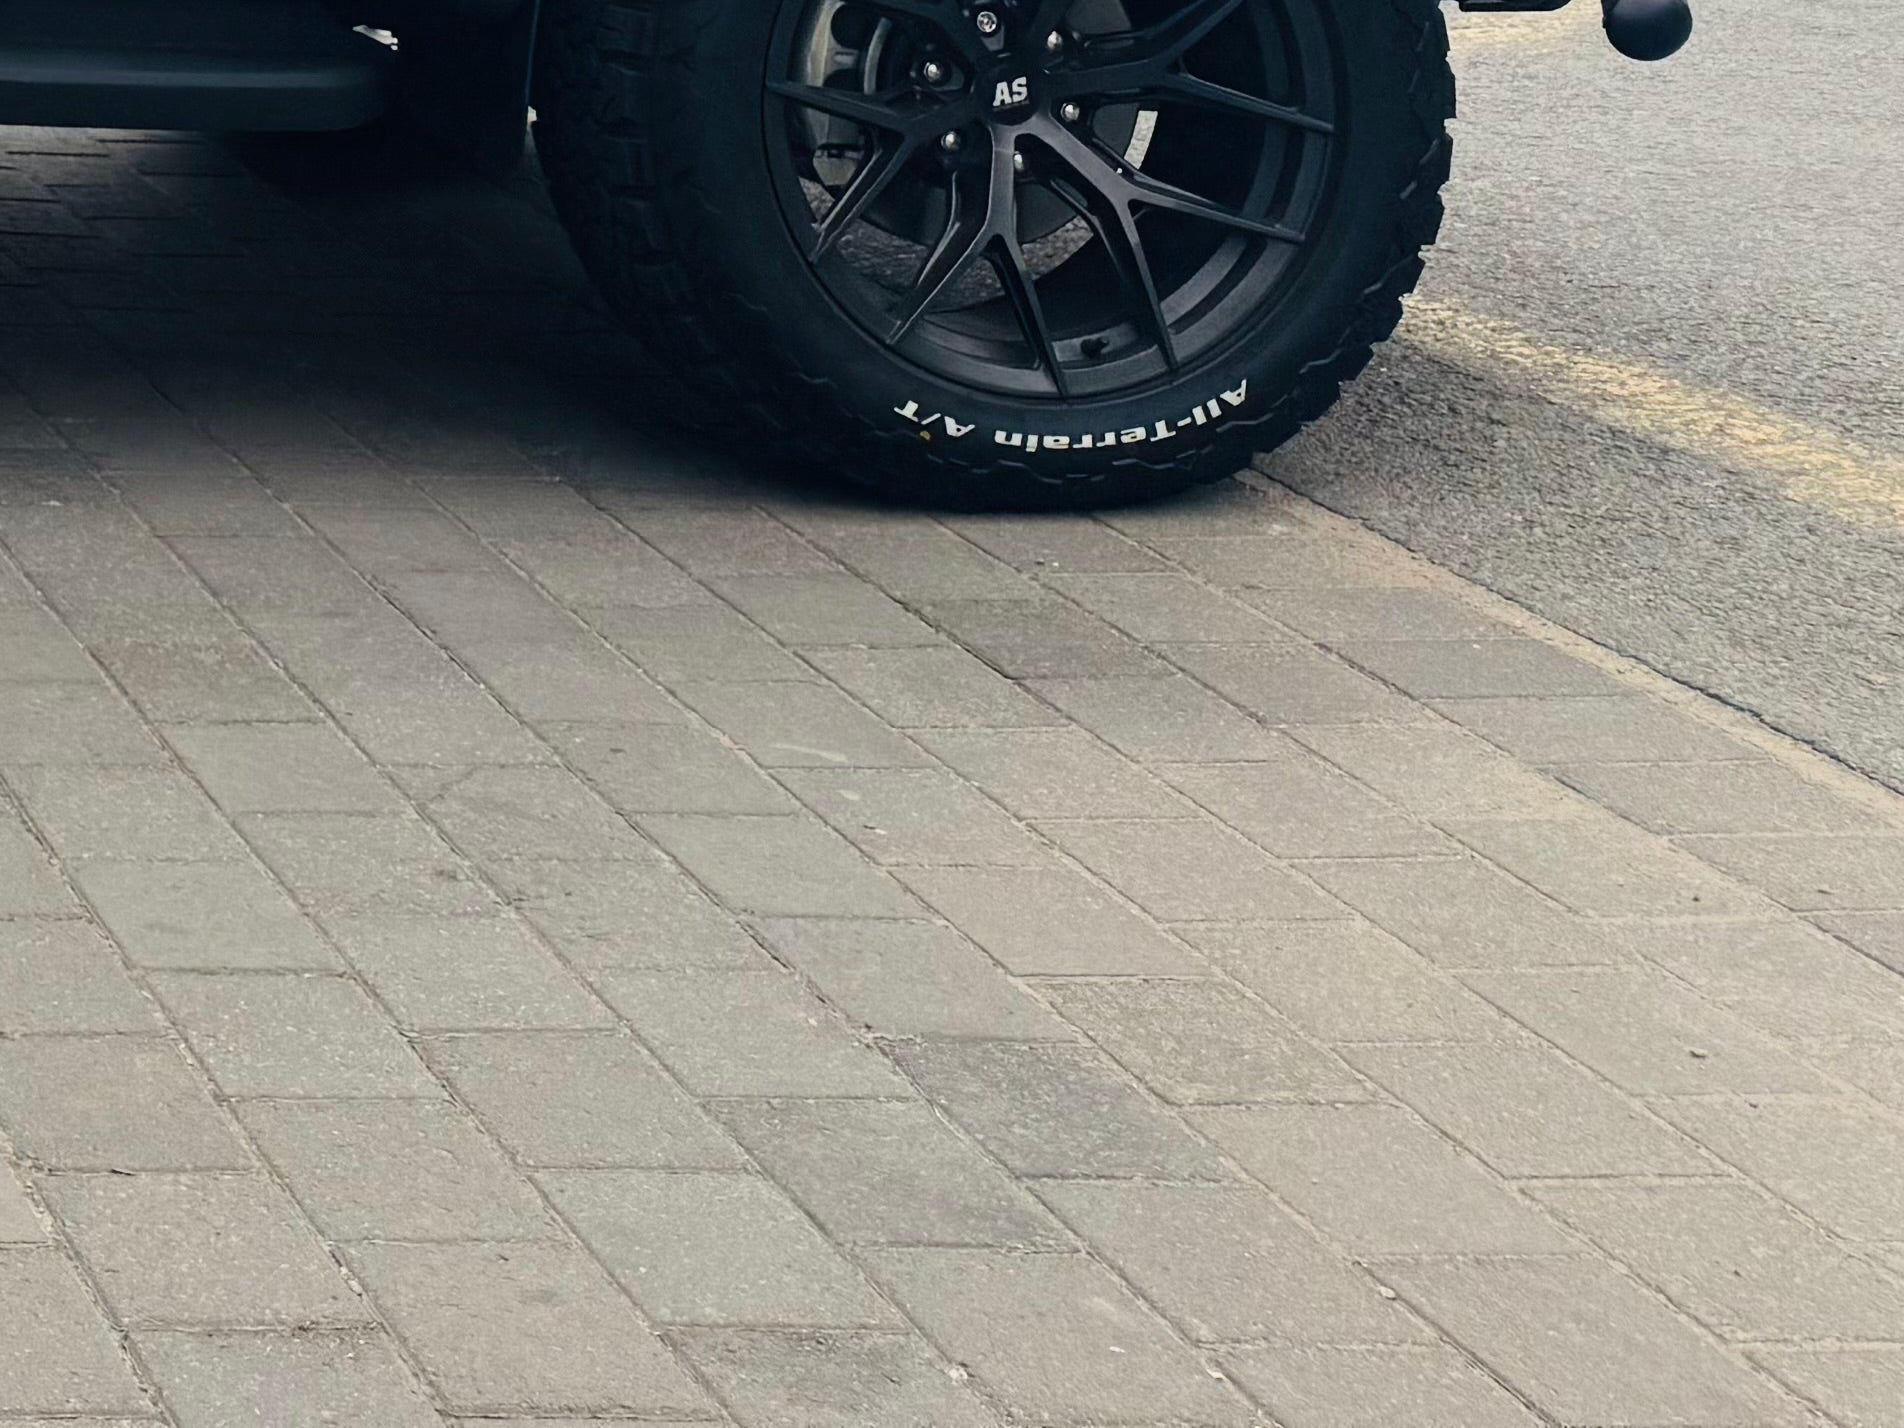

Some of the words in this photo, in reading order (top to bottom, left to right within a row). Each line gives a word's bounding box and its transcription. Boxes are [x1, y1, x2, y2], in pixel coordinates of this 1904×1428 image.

[992, 76, 1028, 107] AS
[893, 399, 976, 438] A/T
[994, 378, 1247, 453] All-Terrain
